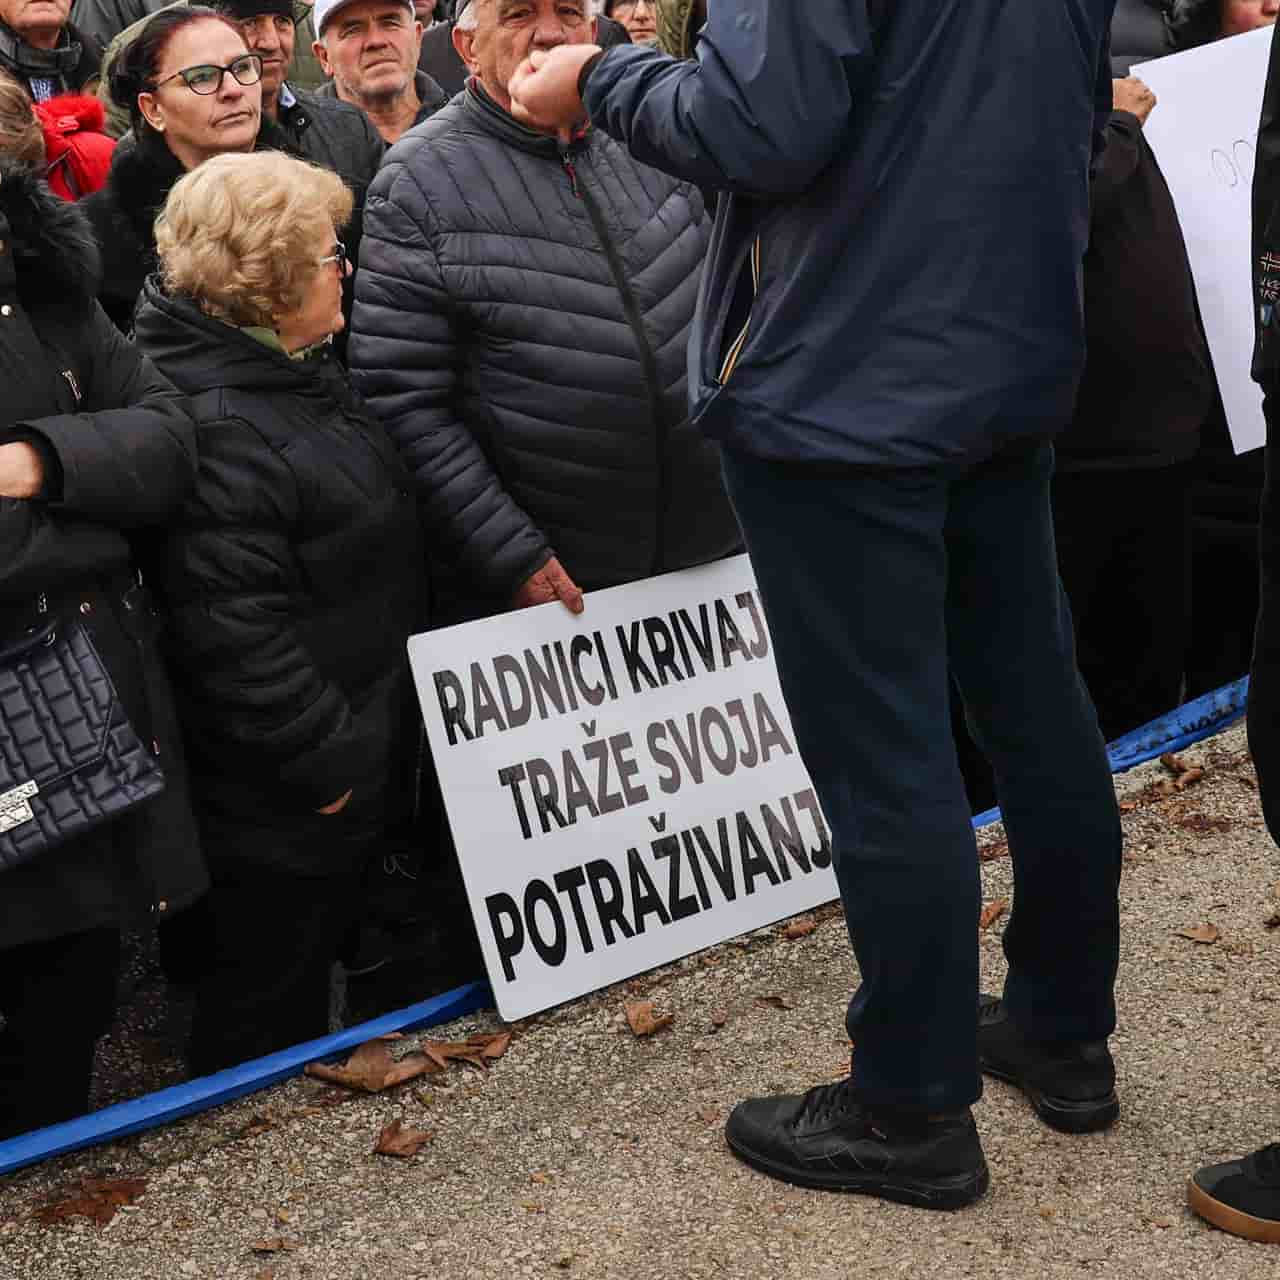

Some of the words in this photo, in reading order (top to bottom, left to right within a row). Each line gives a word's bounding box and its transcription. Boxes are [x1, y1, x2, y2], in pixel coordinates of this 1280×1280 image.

[433, 630, 619, 746] RADNICI
[616, 591, 769, 694] KRIVAJ
[498, 720, 649, 840] TRAŽE
[646, 692, 793, 794] SVOJA
[486, 788, 832, 983] POTRAŽIVANJ
